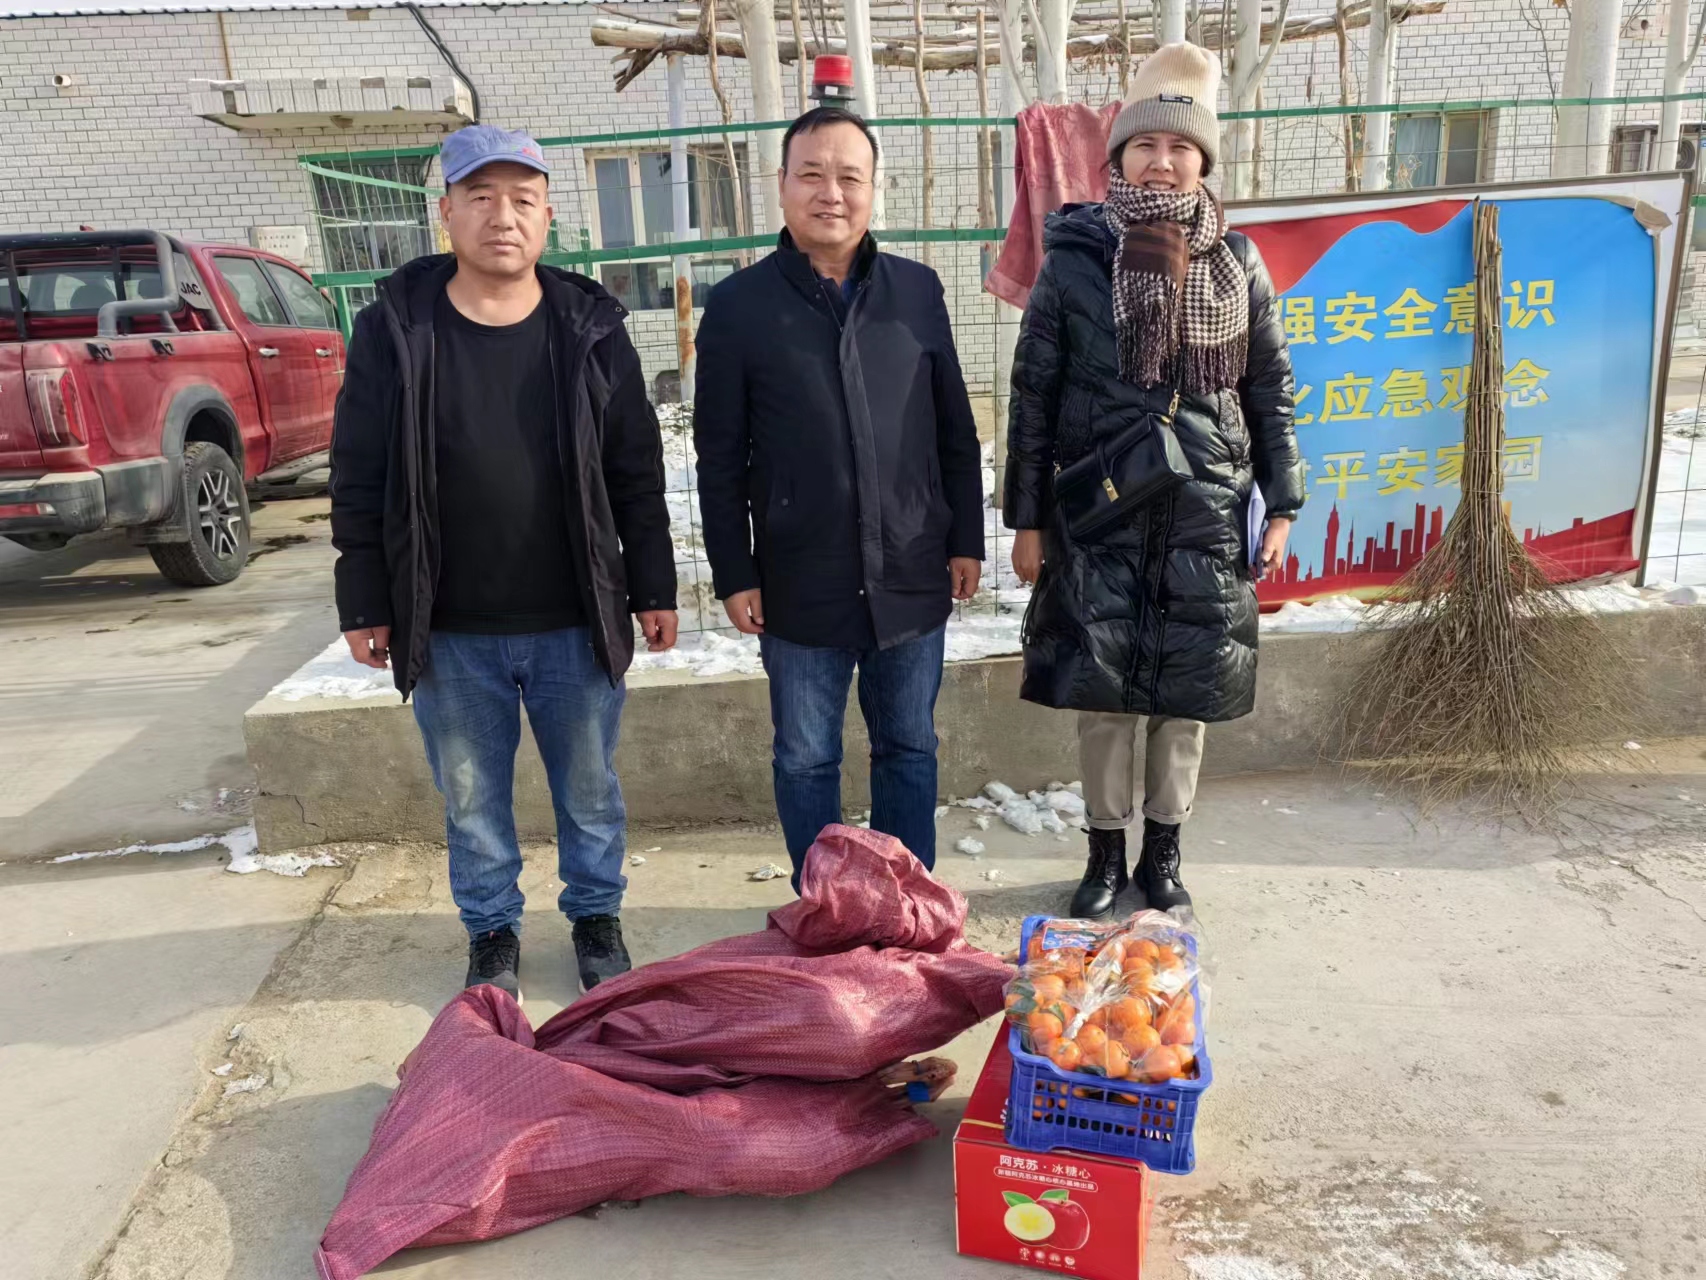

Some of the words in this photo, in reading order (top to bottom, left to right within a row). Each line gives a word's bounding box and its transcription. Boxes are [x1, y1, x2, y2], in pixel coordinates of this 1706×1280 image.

[180, 281, 201, 295] JAC
[1277, 280, 1556, 345] 强安全意识
[1302, 436, 1542, 500] 平安家园
